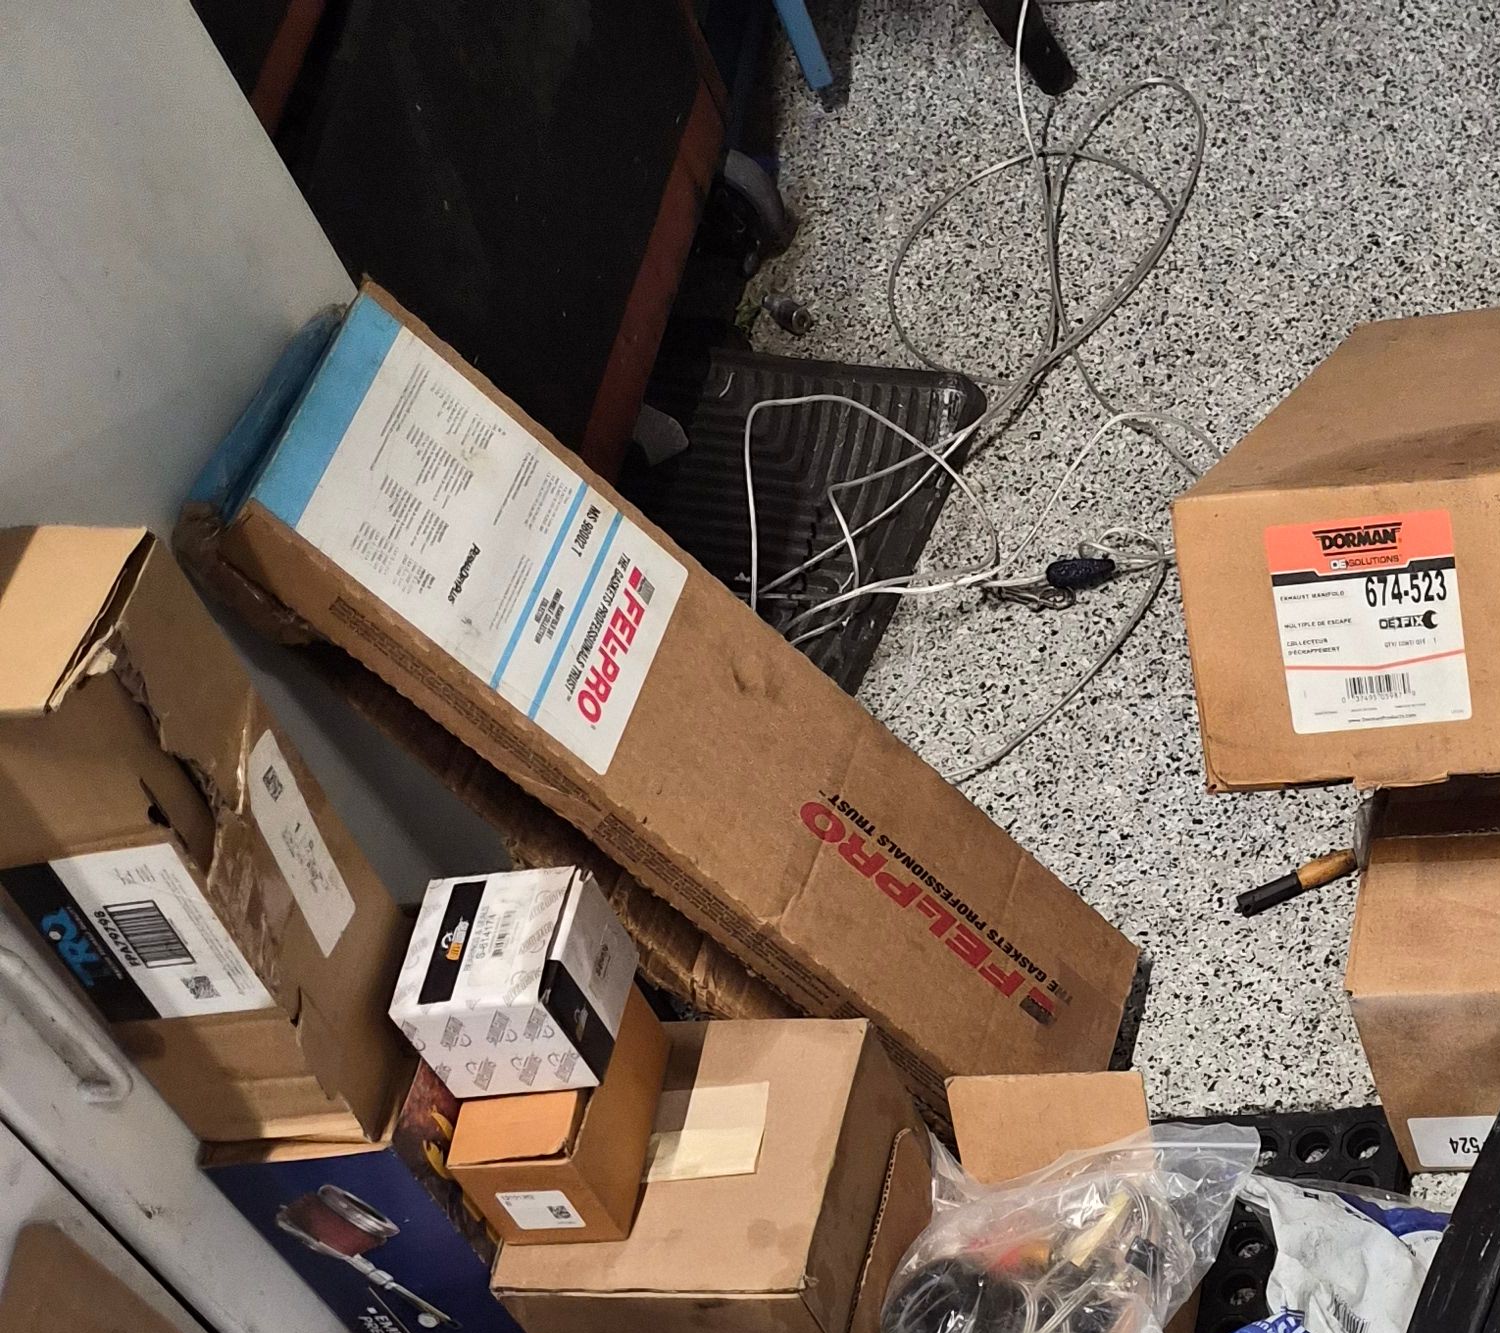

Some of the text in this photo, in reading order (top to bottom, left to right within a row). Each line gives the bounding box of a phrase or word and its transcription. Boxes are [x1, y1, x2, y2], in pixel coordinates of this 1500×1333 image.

[586, 504, 601, 522] MS
[1317, 527, 1401, 551] DORMAN
[1365, 569, 1447, 608] 674-523
[564, 552, 631, 696] THE GASKETS PROFESSIONALS TRUST
[577, 587, 645, 724] FEL-PRO
[827, 793, 877, 842] TRUST
[800, 801, 1025, 998] FEL-PRO
[876, 833, 988, 932] PROFESSIONALS
[986, 928, 1049, 983] GASKETS
